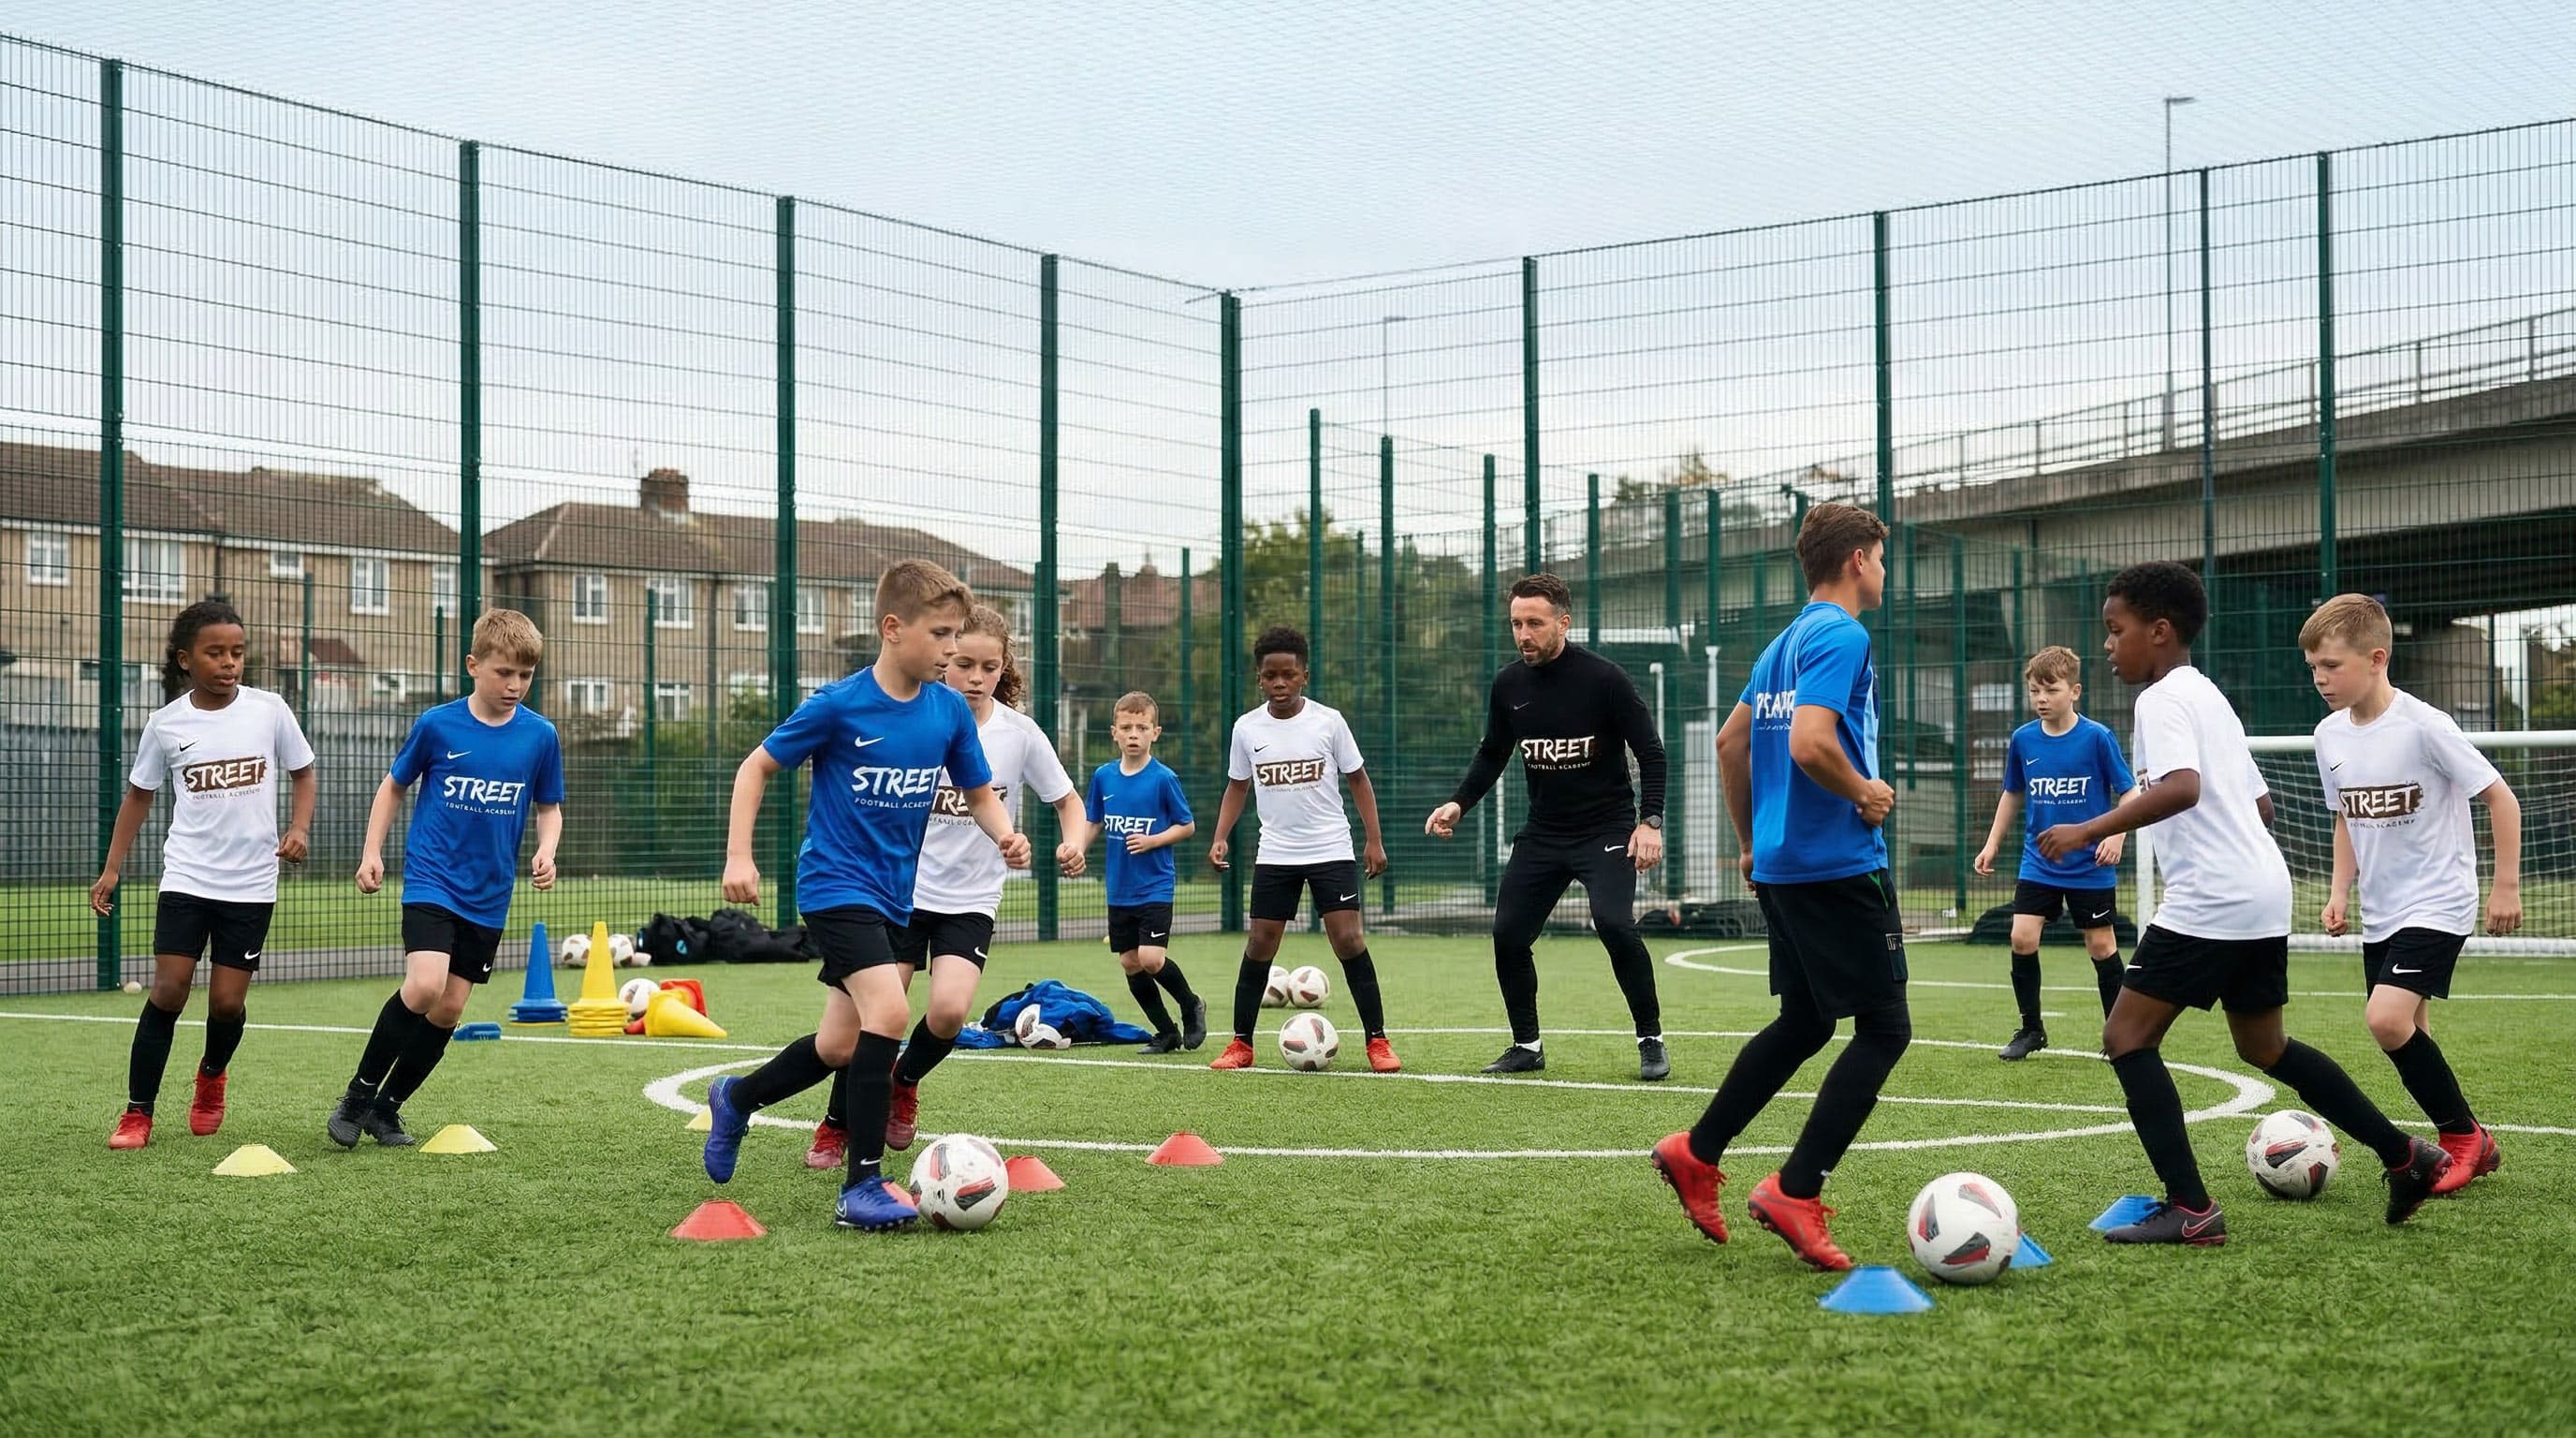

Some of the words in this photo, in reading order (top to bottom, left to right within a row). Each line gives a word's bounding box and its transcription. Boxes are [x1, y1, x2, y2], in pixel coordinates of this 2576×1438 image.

[1520, 735, 1595, 762] STREET
[185, 758, 266, 789] STREET
[851, 765, 942, 798] STREET
[1259, 758, 1325, 785] STREET
[443, 775, 526, 806] STREET
[2029, 776, 2092, 798] STREET
[2339, 785, 2419, 817] STREET
[1105, 814, 1157, 836] STREET
